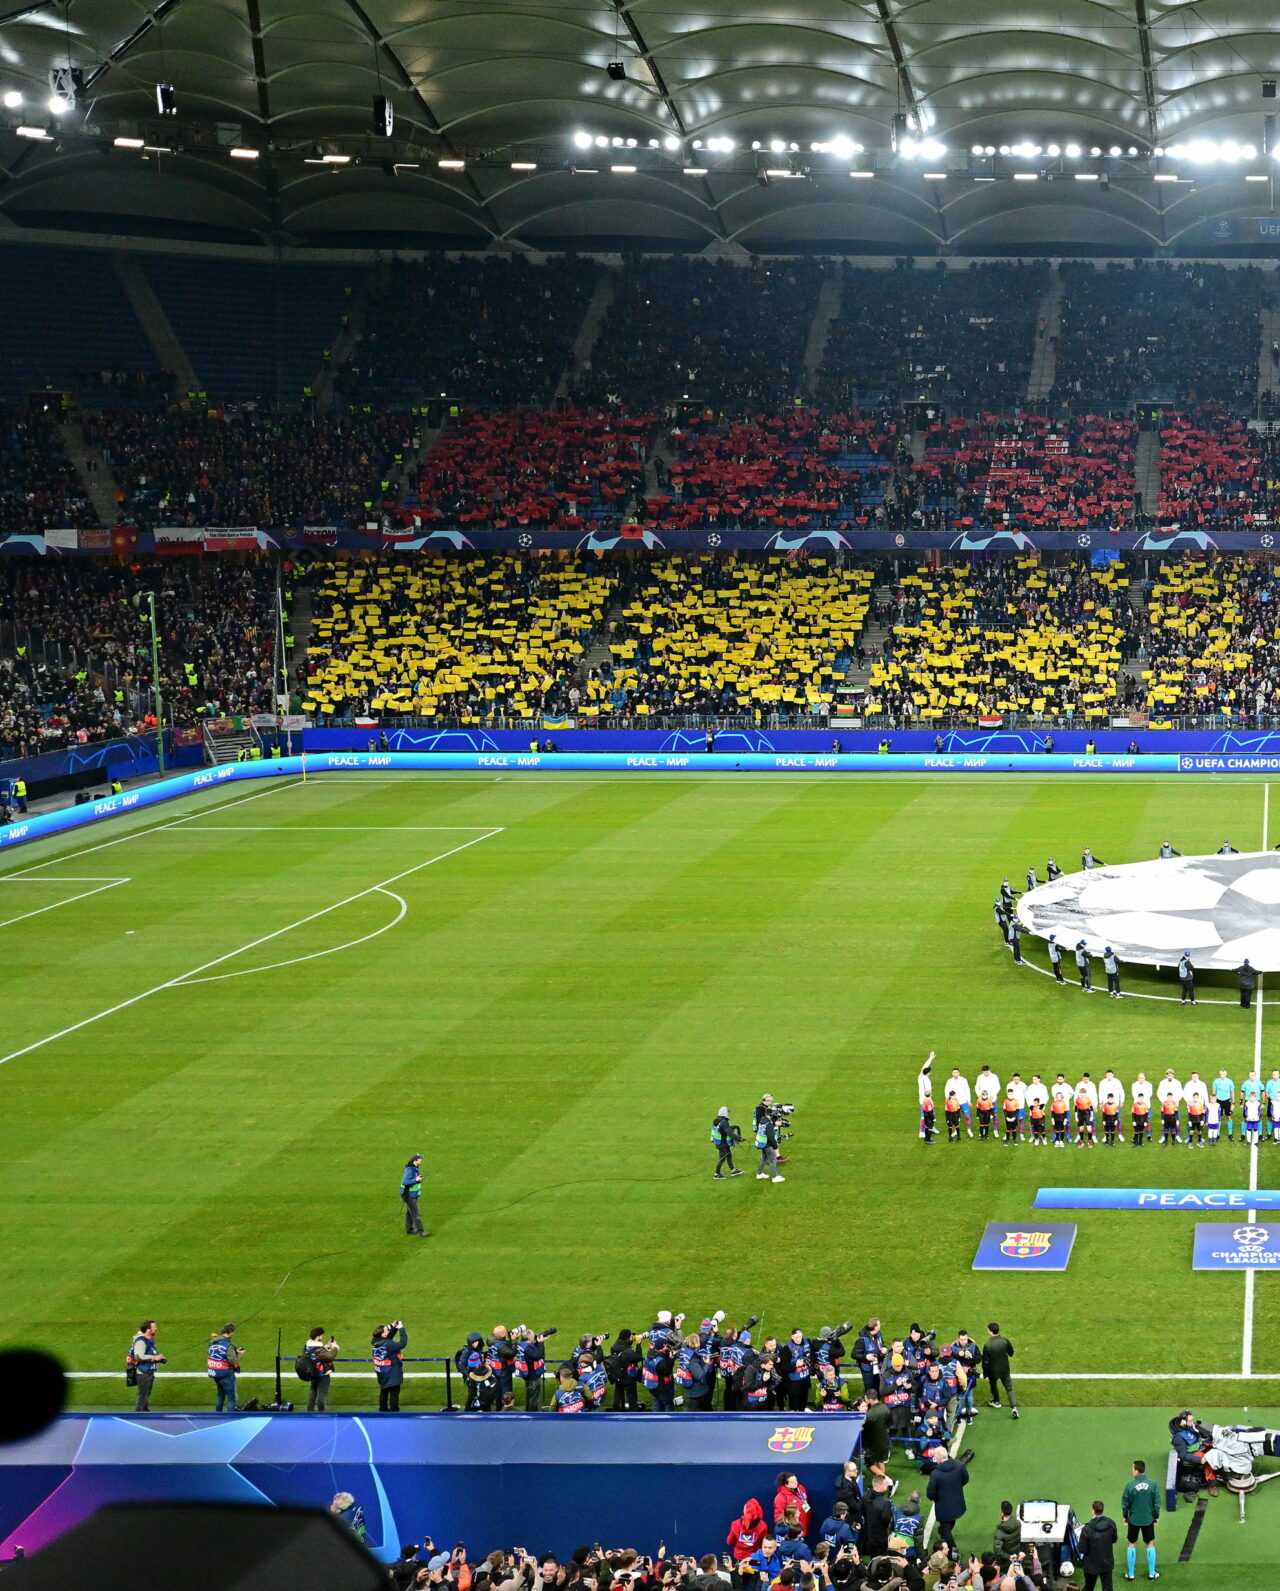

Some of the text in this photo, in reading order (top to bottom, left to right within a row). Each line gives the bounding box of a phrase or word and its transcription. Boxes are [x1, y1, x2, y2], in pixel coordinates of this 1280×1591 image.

[329, 757, 359, 766] PEACE
[479, 757, 508, 766] PEACE
[627, 757, 657, 766] PEACE
[776, 758, 806, 767] PEACE
[925, 758, 954, 767] PEACE
[1073, 759, 1103, 768] PEACE
[1195, 758, 1225, 768] UEFA
[193, 774, 212, 786] PEACE
[95, 802, 117, 815] PEACE
[1138, 1193, 1246, 1206] PEACE
[888, 1393, 909, 1402] PHOTO
